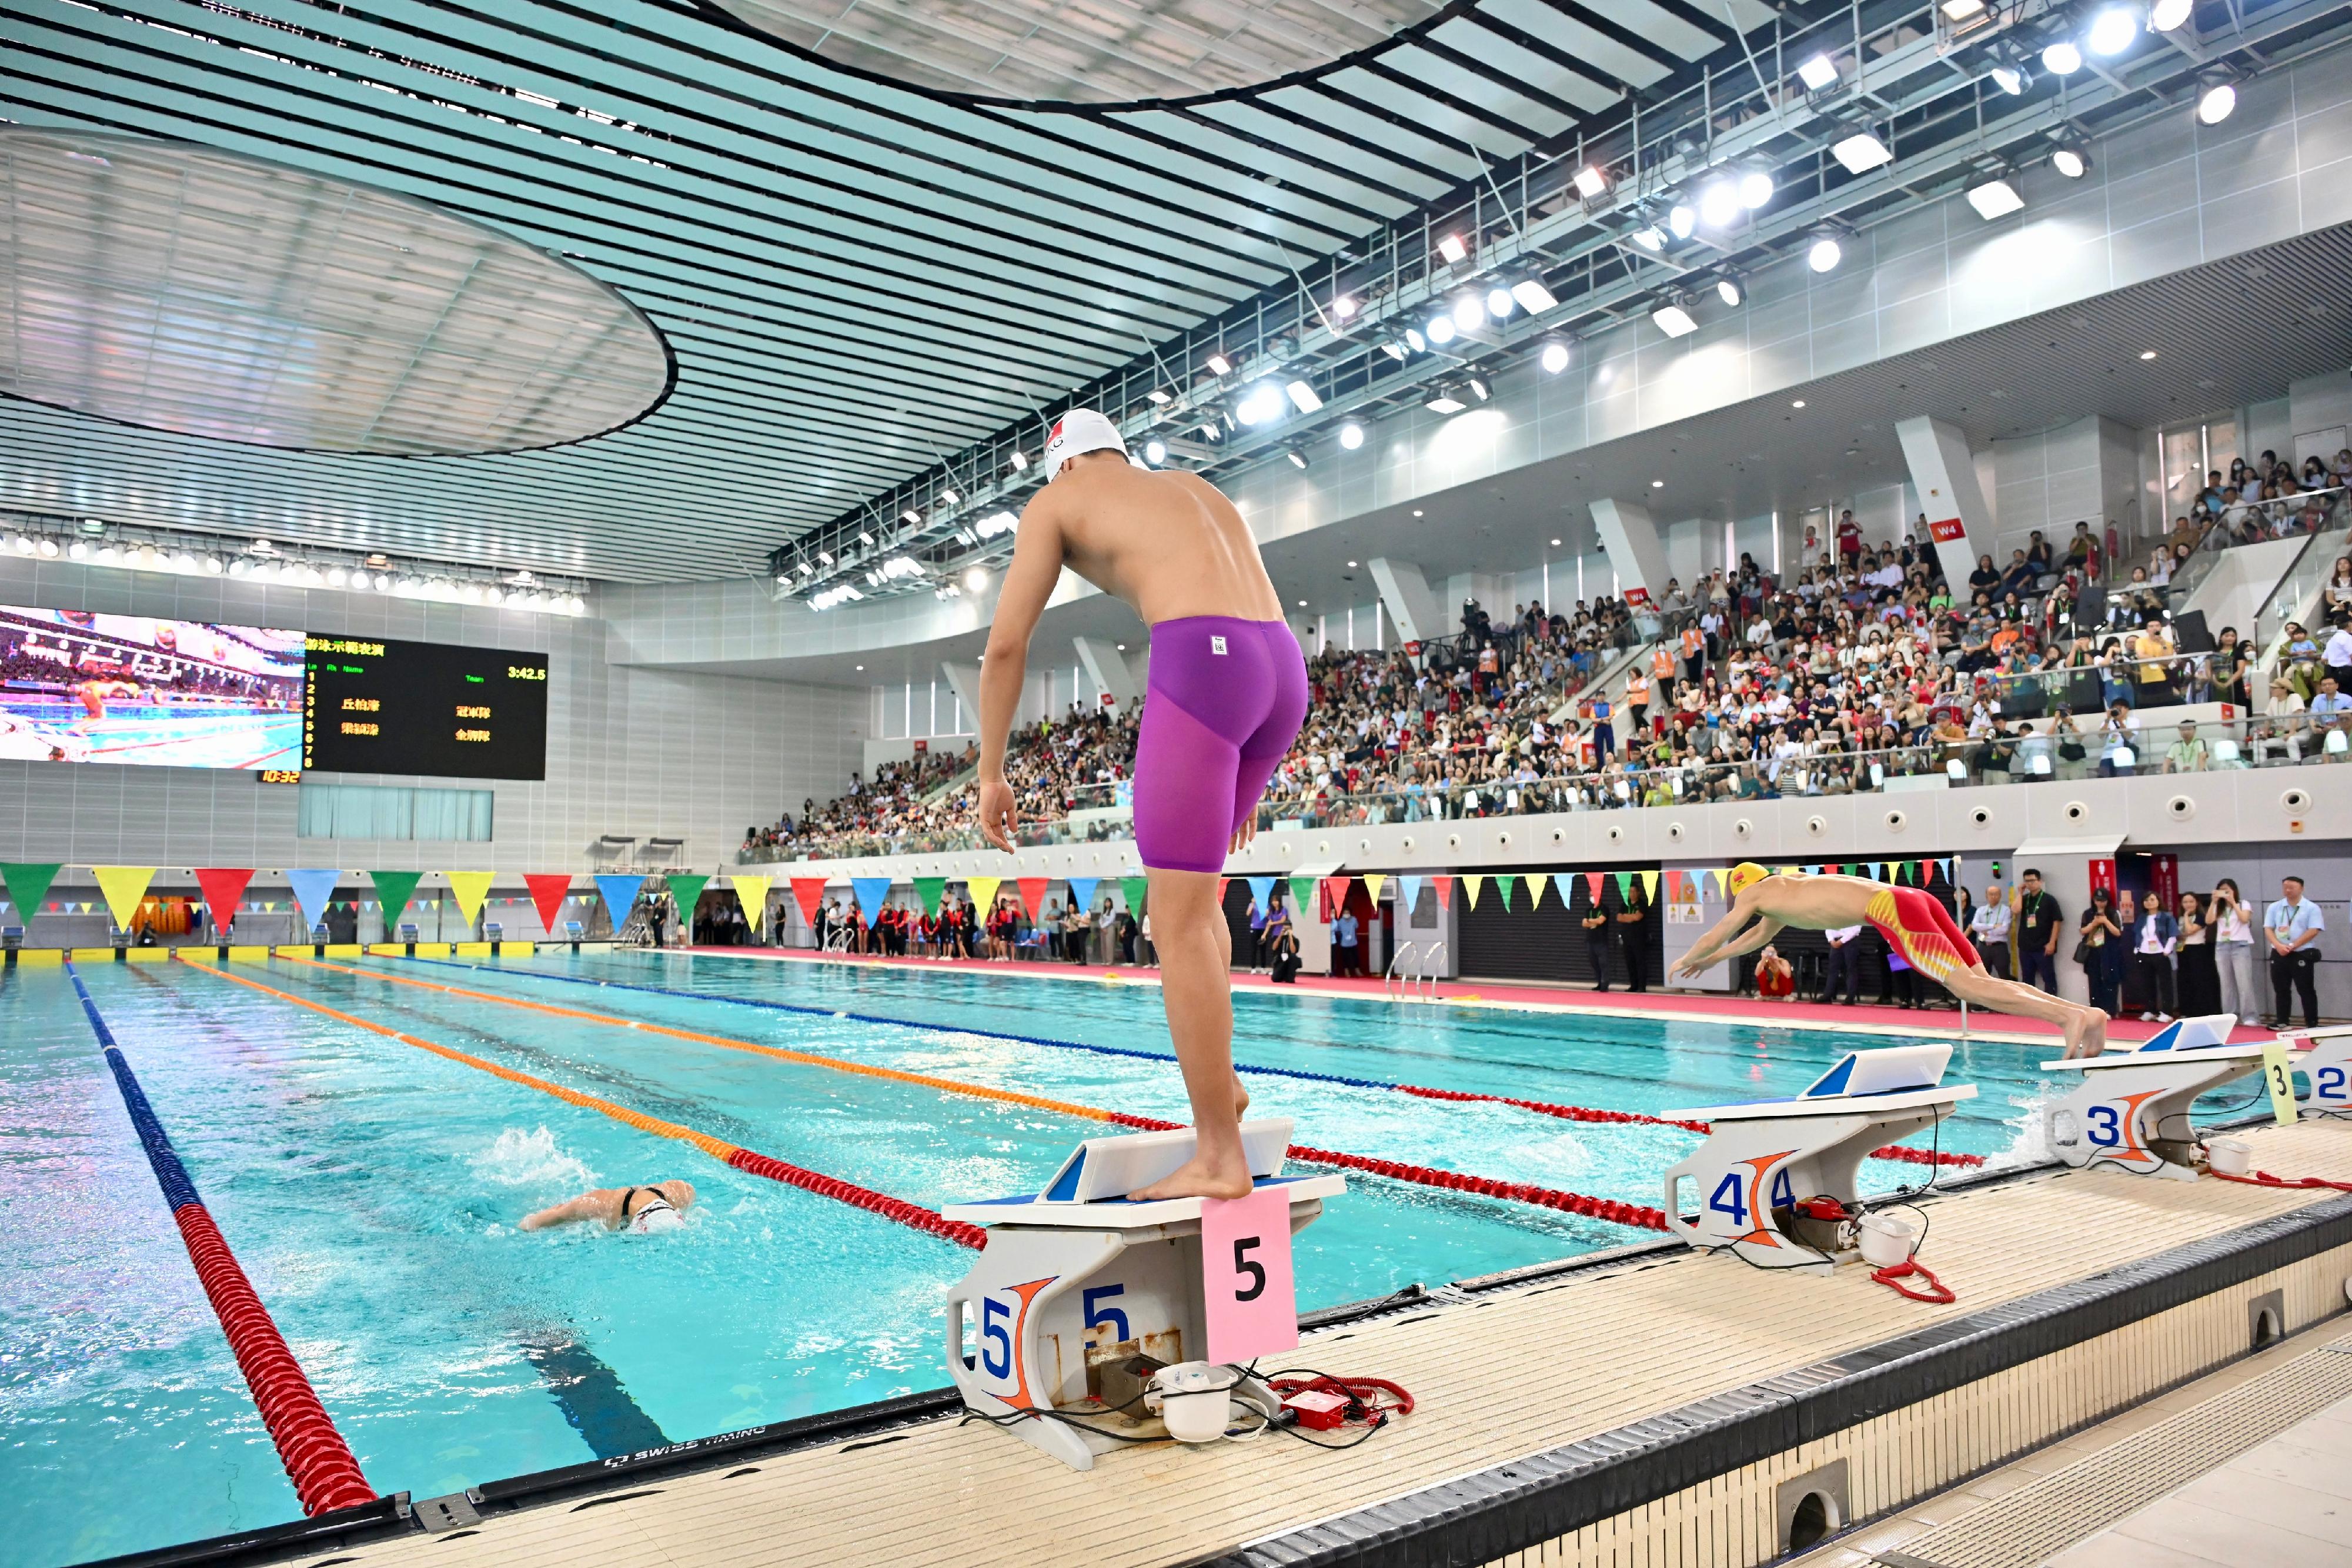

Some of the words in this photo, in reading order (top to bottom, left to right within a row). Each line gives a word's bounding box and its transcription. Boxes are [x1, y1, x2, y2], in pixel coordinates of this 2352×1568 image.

[305, 638, 385, 657] 游泳示範表演
[308, 672, 315, 681] 1
[343, 666, 364, 674] Name
[508, 666, 546, 680] 3:42.5
[306, 684, 315, 694] 2
[306, 696, 315, 706] 3
[306, 708, 314, 718] 4
[306, 721, 315, 731] 5
[305, 733, 314, 743] 6
[305, 745, 313, 755] 7
[304, 757, 312, 768] 8
[262, 770, 300, 783] 10:32
[2273, 1065, 2287, 1096] 3
[2318, 1067, 2347, 1099] 2
[2087, 1106, 2120, 1146] 3
[1771, 1166, 1796, 1215] 4
[1709, 1173, 1747, 1226] 4
[1234, 1236, 1266, 1302] 5
[1083, 1283, 1129, 1349] 5
[982, 1296, 1010, 1379] 5
[634, 1440, 699, 1461] SWISS
[704, 1425, 766, 1446] TIMING
